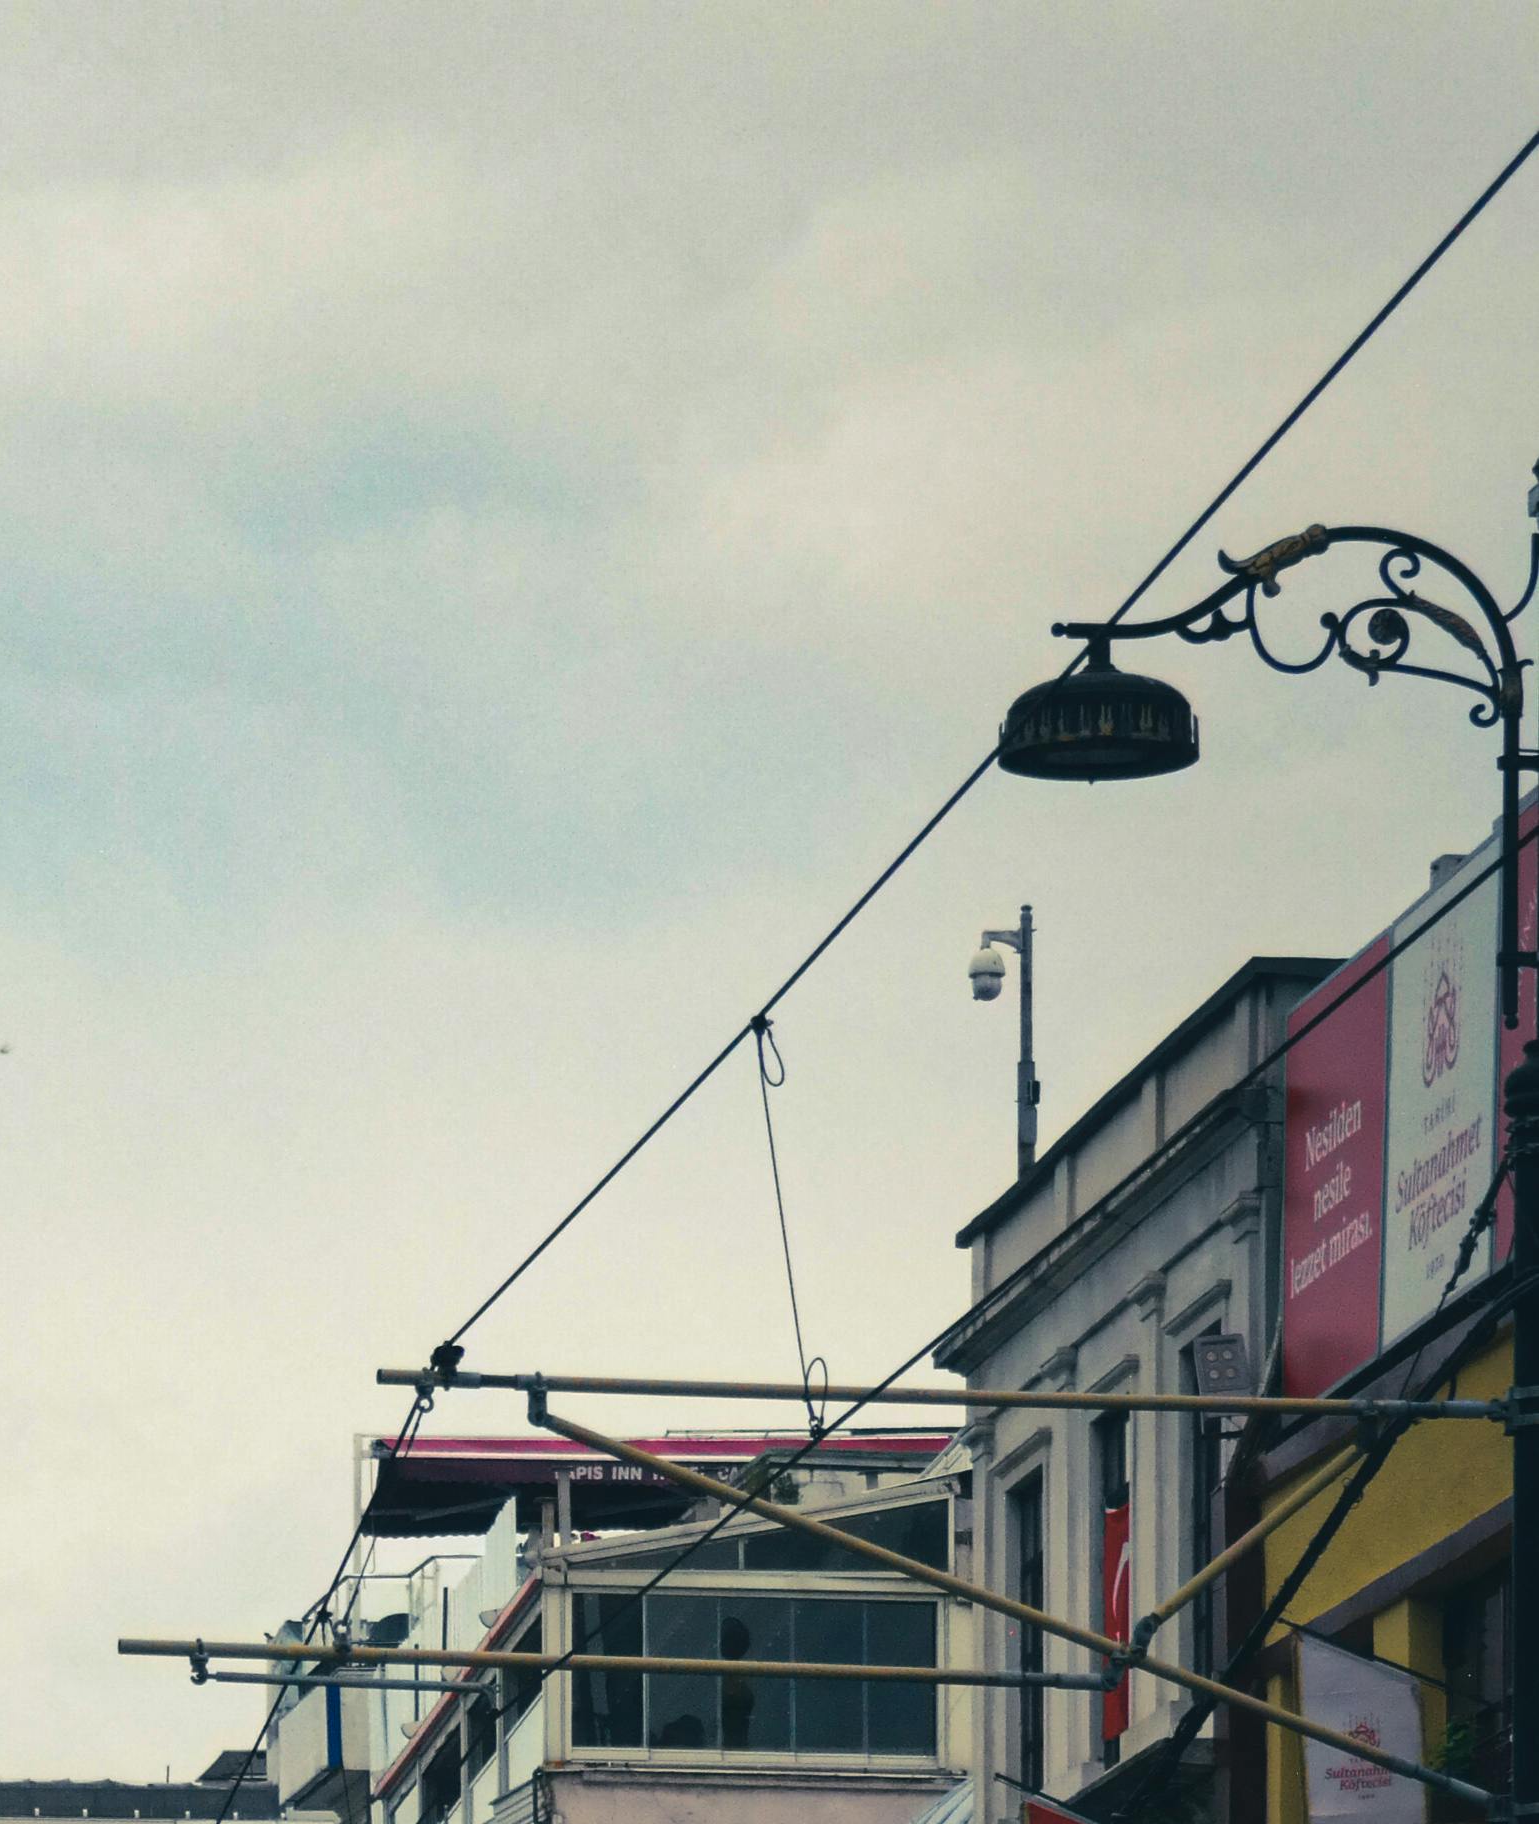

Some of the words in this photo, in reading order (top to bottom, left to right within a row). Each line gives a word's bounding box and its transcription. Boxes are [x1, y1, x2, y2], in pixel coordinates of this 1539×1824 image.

[1304, 1099, 1362, 1172] Nesilden
[1395, 1112, 1483, 1214] Sultanahmet
[1313, 1161, 1352, 1222] nesile
[1407, 1167, 1468, 1251] Köftecisi
[1290, 1245, 1327, 1299] lezzet
[612, 1466, 643, 1481] INN
